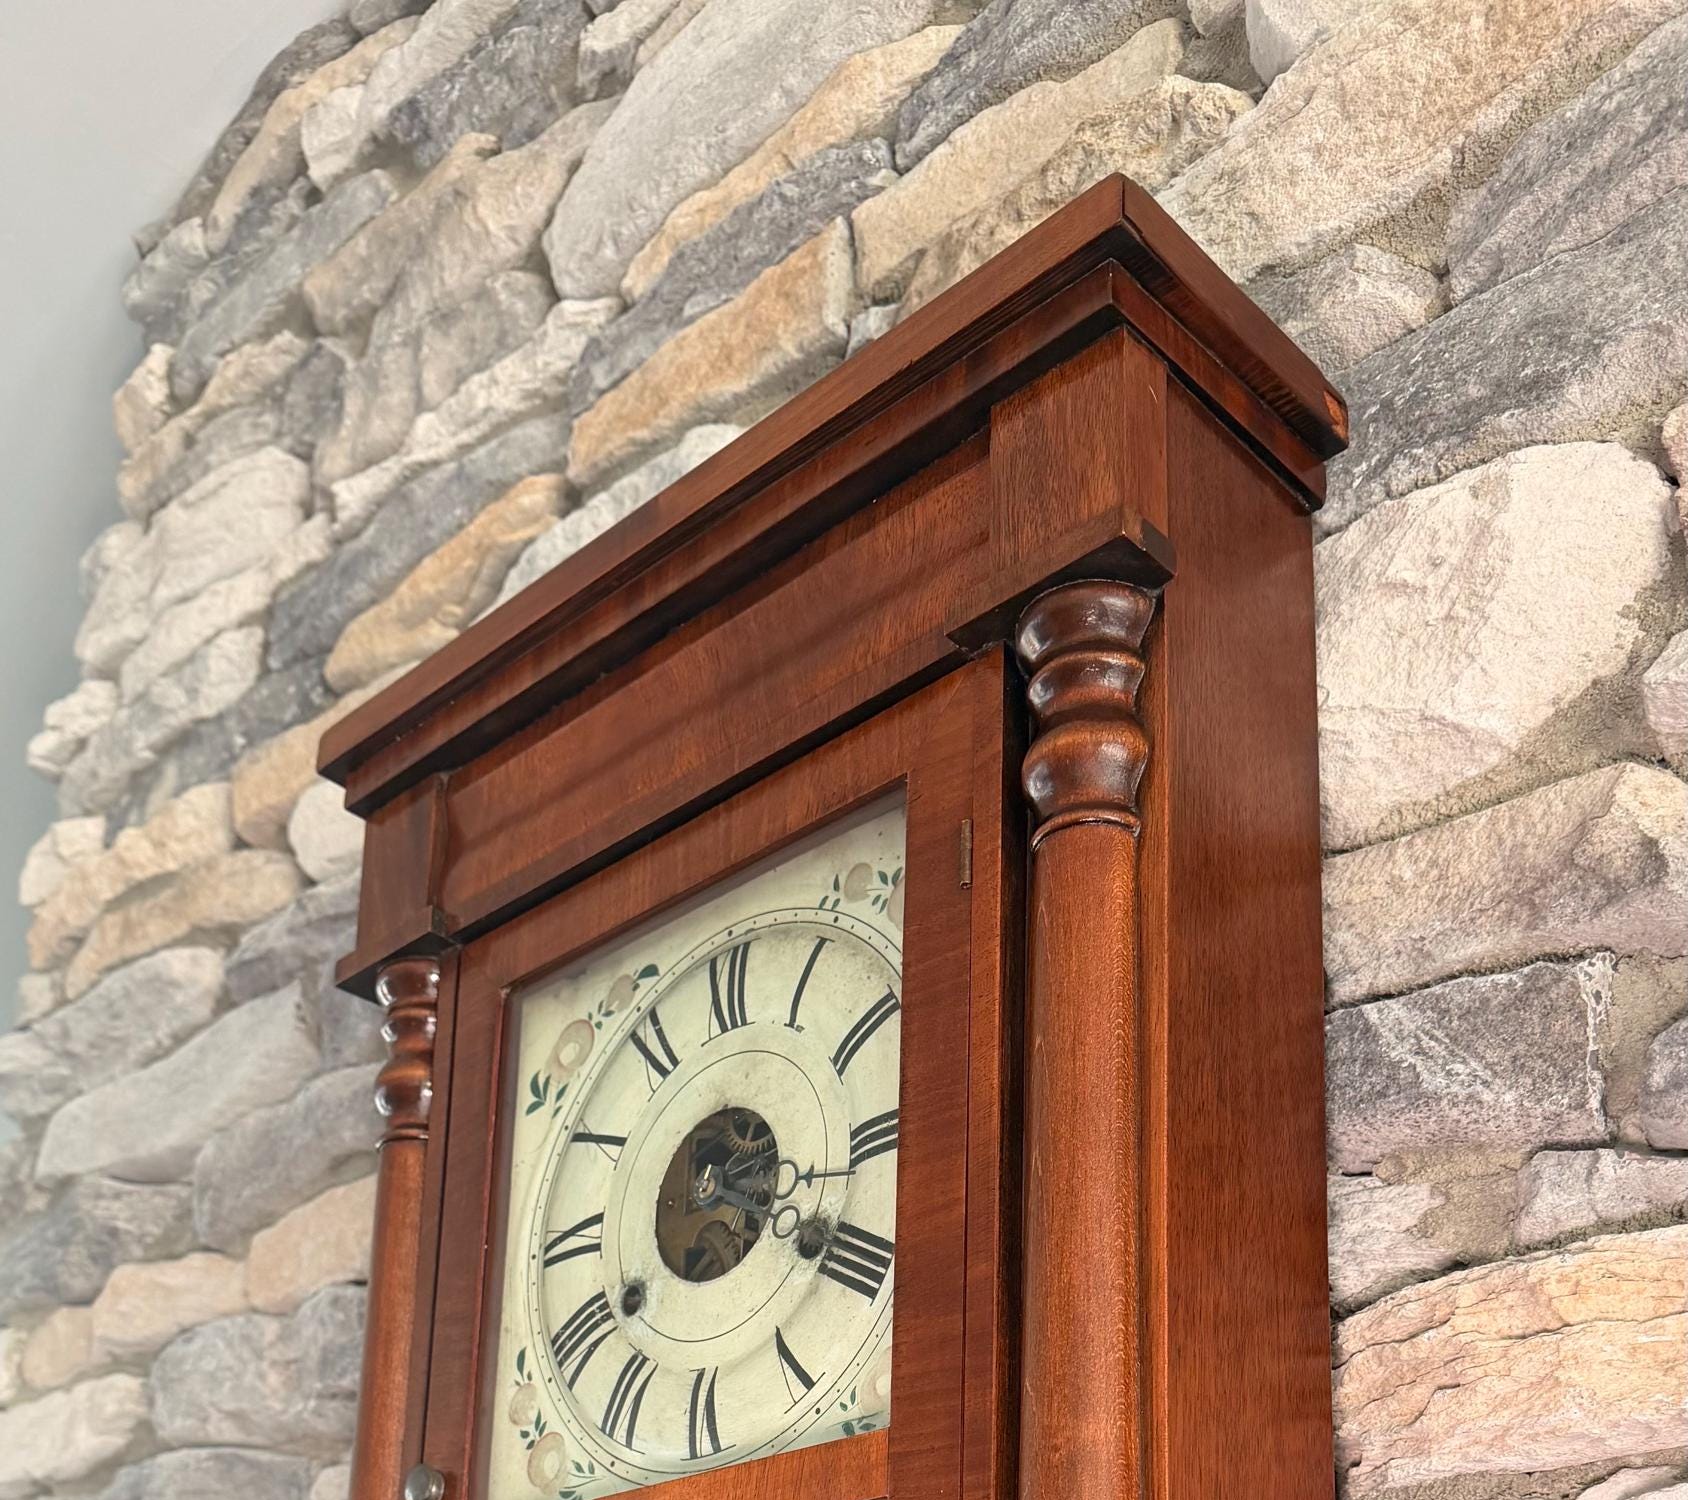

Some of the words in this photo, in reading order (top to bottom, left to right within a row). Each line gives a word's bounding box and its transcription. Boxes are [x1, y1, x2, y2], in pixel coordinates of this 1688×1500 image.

[701, 937, 760, 1047] XII
[783, 935, 836, 1033] I
[629, 1005, 683, 1102] XI
[829, 984, 901, 1085] II
[569, 1116, 632, 1171] X
[846, 1089, 899, 1190] III
[543, 1206, 606, 1269] IX
[817, 1216, 895, 1307] IIII
[549, 1285, 619, 1404] VIII
[775, 1325, 826, 1414] V
[592, 1343, 659, 1455] VII
[680, 1366, 736, 1461] VI
